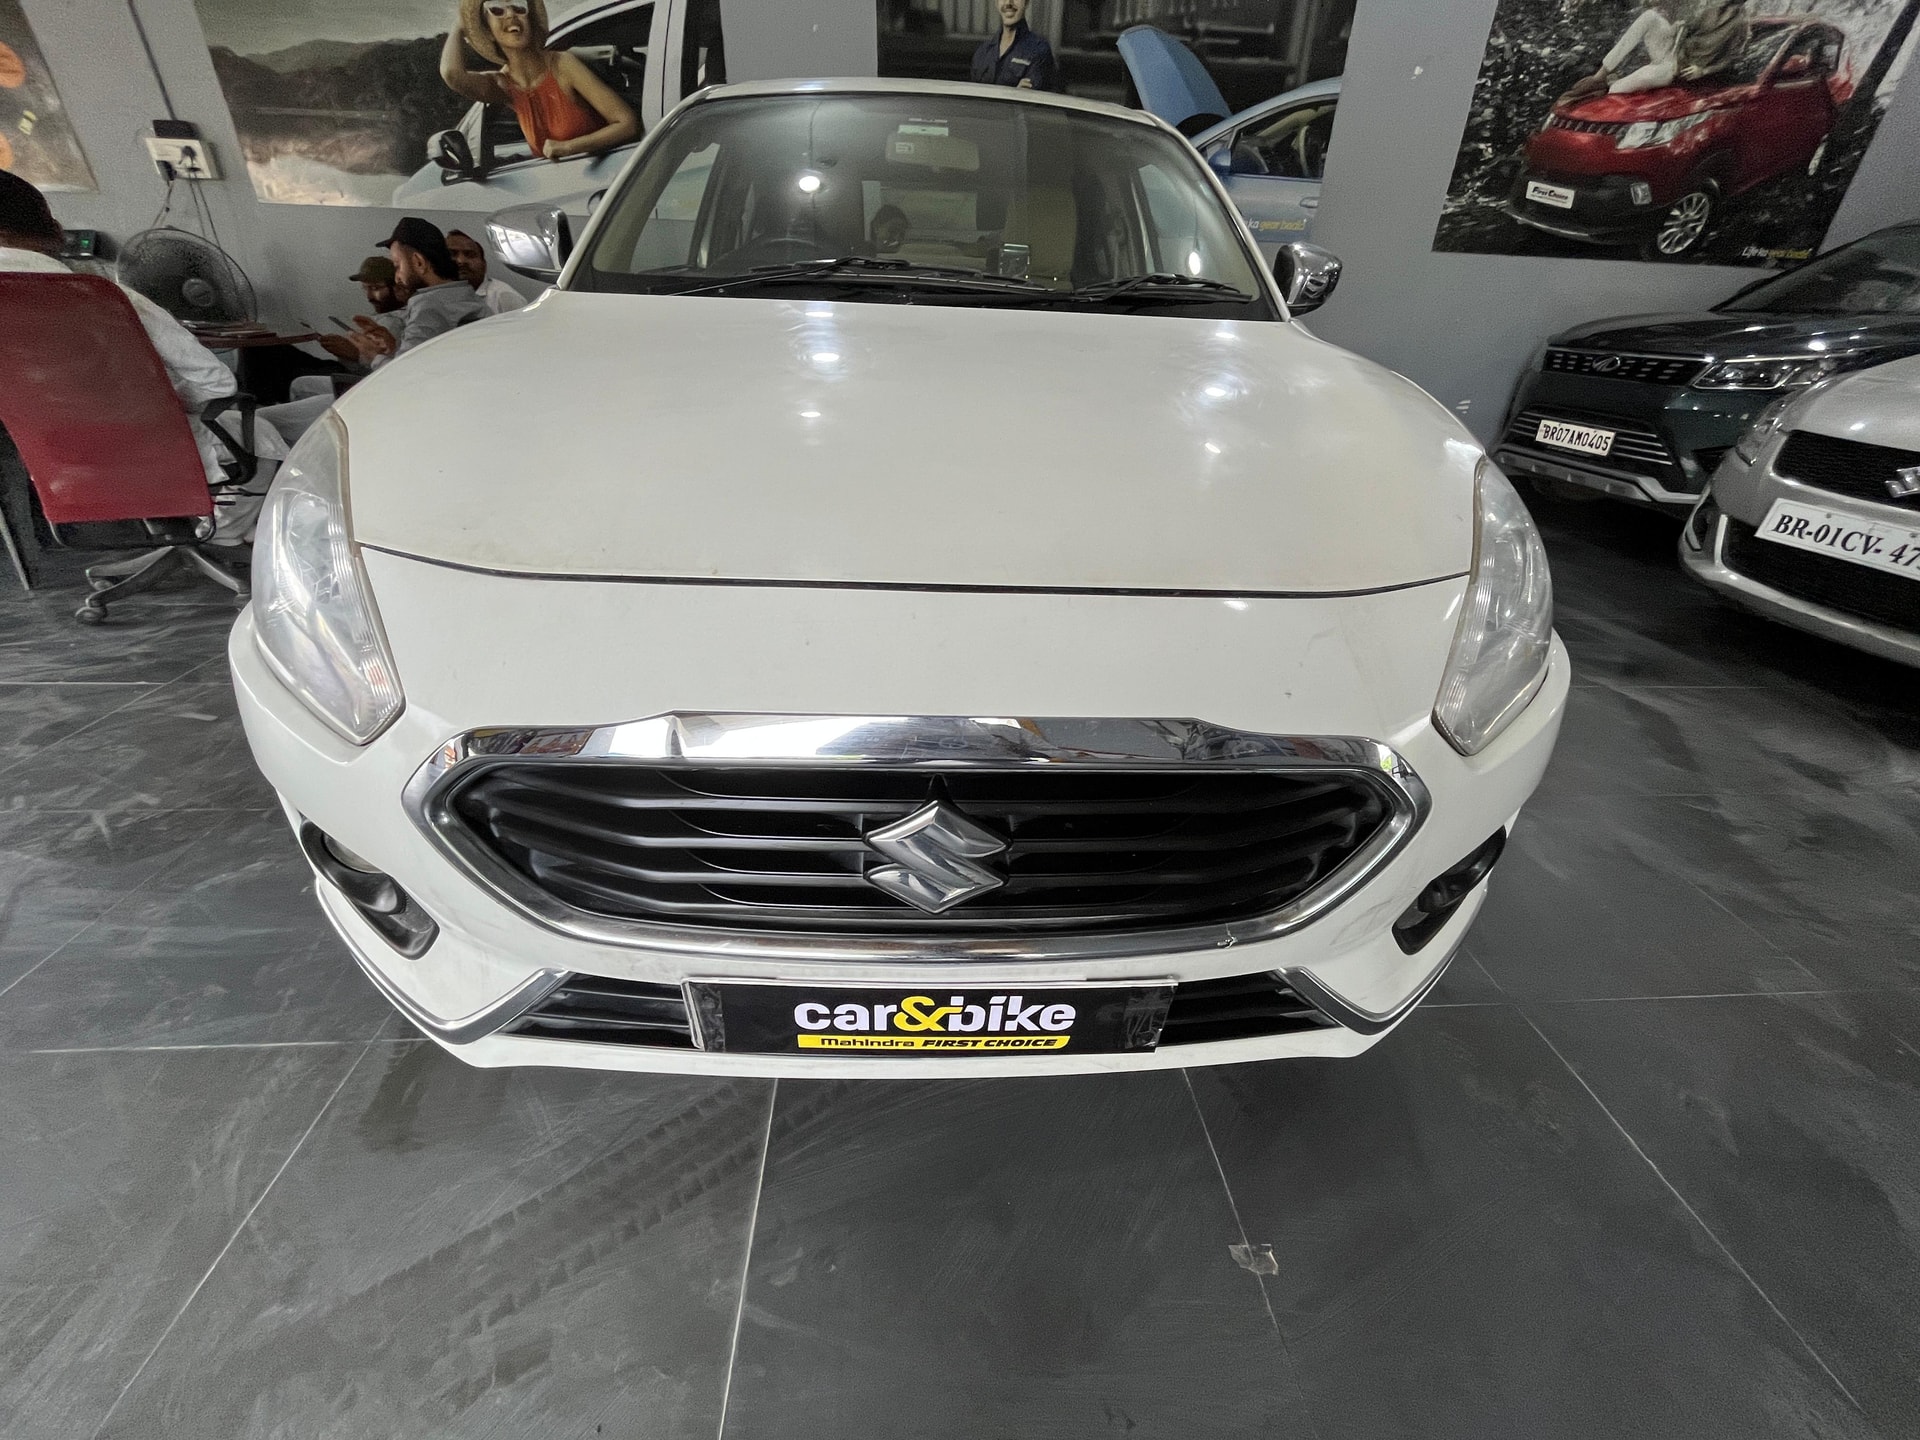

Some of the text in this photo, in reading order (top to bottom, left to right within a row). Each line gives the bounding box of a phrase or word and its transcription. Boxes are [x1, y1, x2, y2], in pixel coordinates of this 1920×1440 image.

[1543, 424, 1611, 451] BR07AM0405
[1889, 543, 1920, 571] 47
[794, 995, 1077, 1032] car&bike
[820, 1038, 1058, 1047] Mahindra FIRST CHOICE
